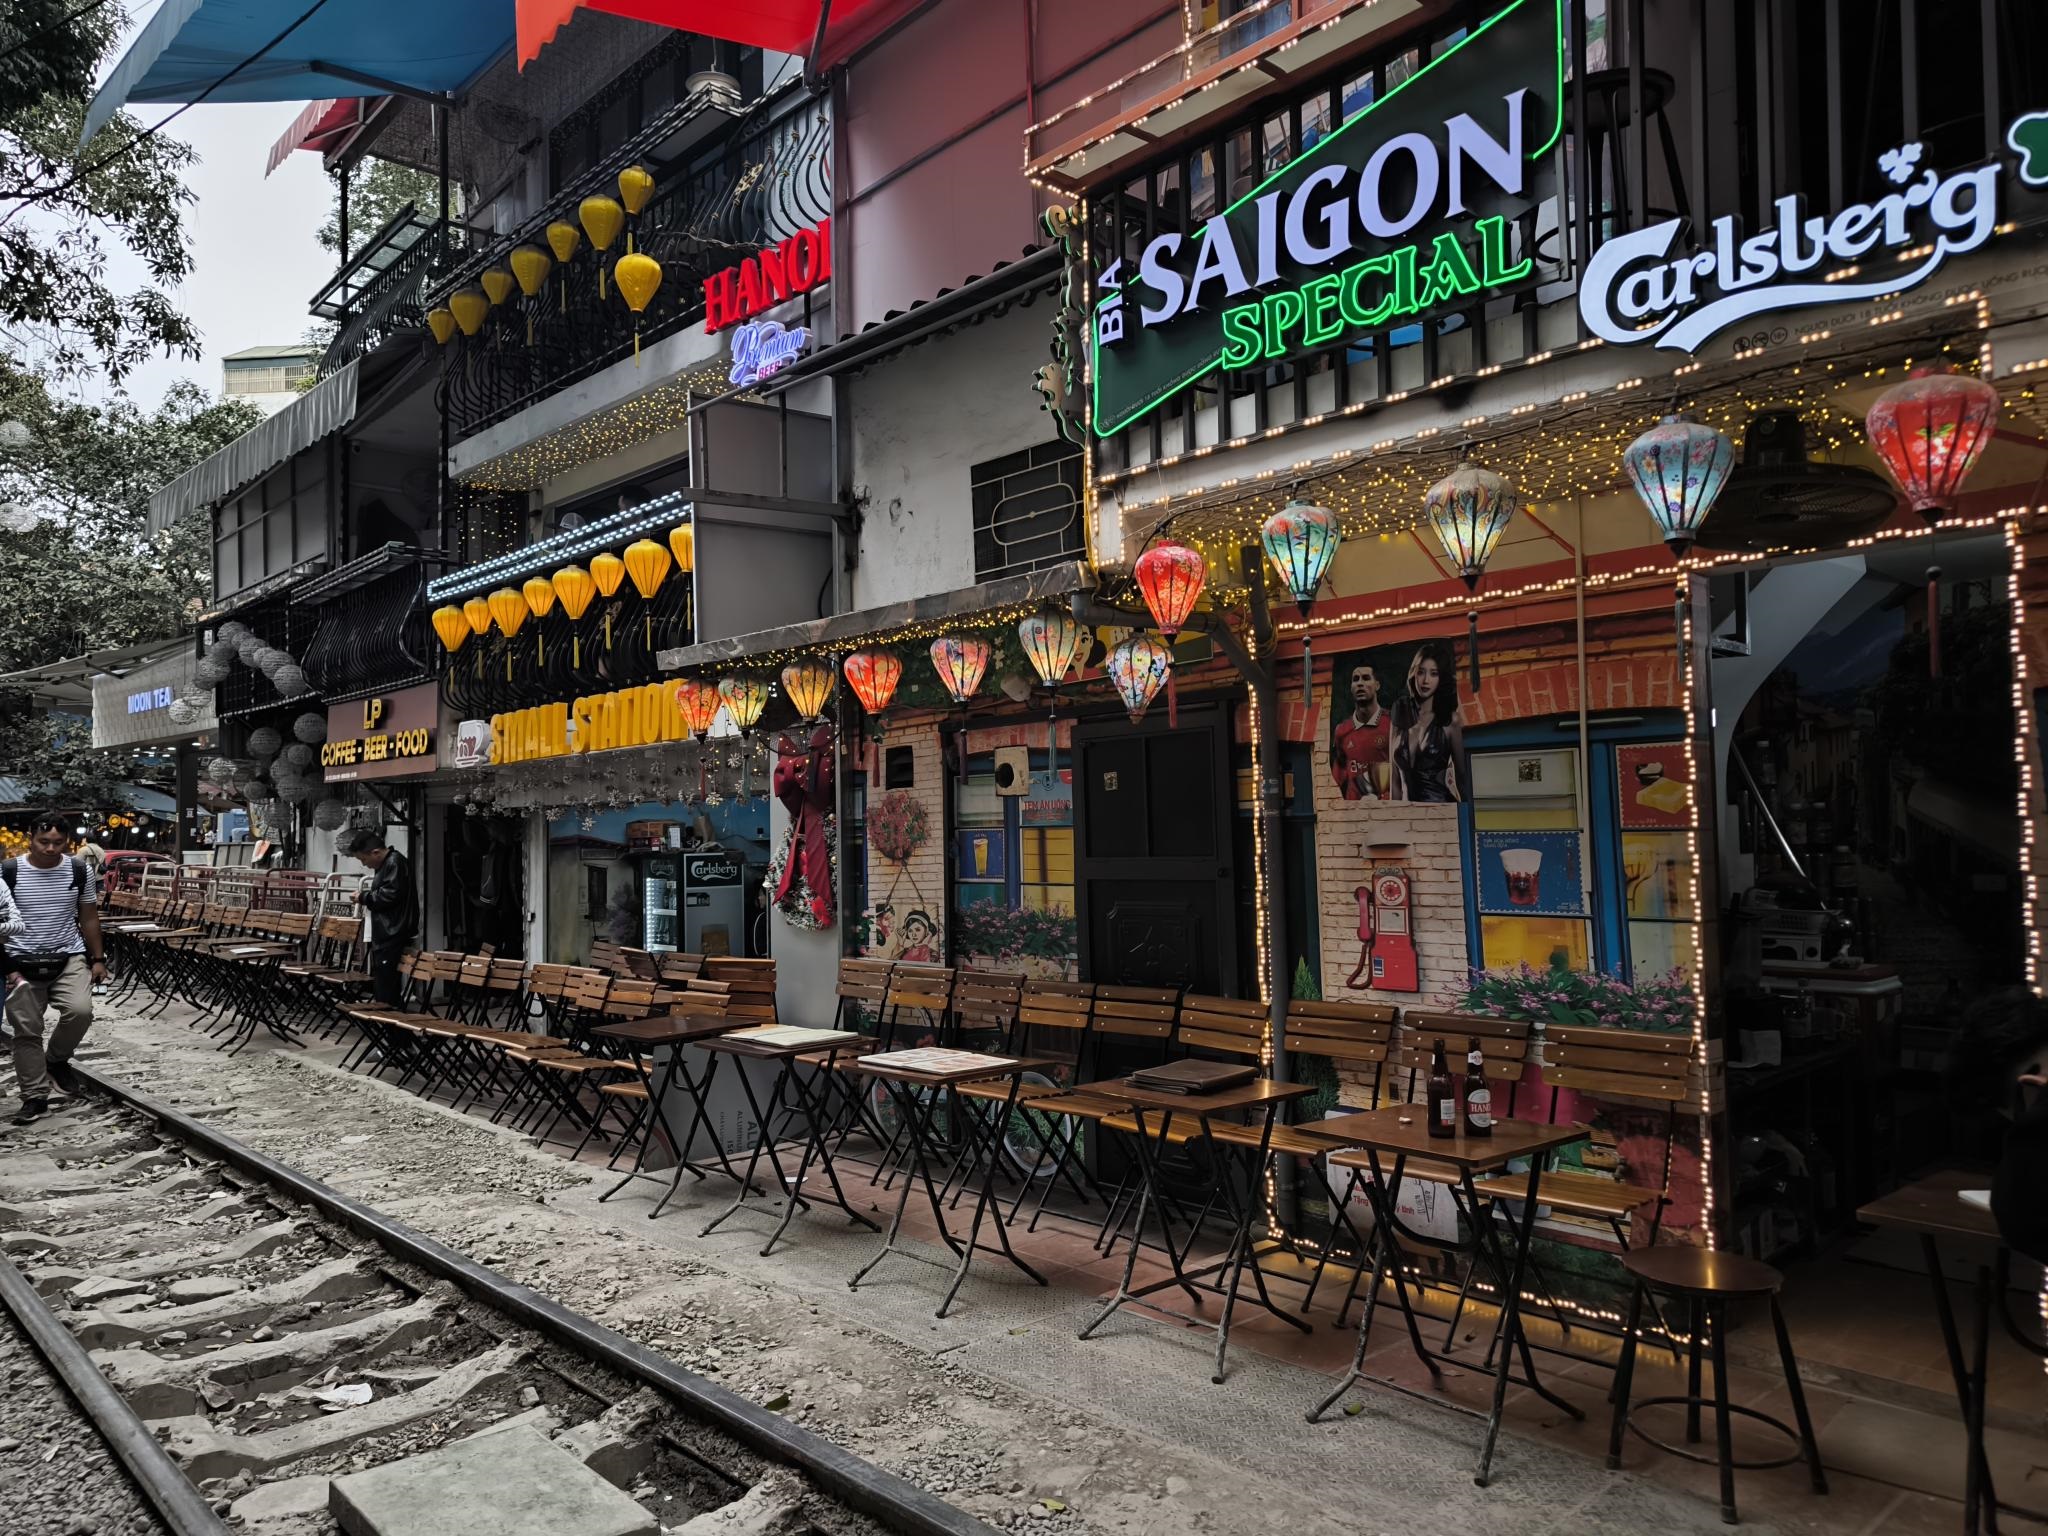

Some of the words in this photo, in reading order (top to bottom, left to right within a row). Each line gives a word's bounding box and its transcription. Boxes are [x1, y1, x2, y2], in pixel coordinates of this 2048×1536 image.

[1138, 87, 1529, 328] SAIGON
[1579, 150, 2001, 352] Carlsberg
[703, 216, 831, 335] HANOI
[1098, 256, 1124, 346] BIA
[1221, 215, 1532, 370] SPECIAL
[729, 321, 808, 387] Premium
[127, 691, 152, 714] MOON
[153, 686, 171, 708] TEA
[363, 699, 382, 729] LP
[490, 702, 571, 765] SMALL
[572, 678, 688, 753] STATION
[321, 739, 357, 767] COFFEE
[364, 734, 388, 763] BEER
[395, 728, 428, 758] FOOD
[691, 860, 738, 880] Carlsberg
